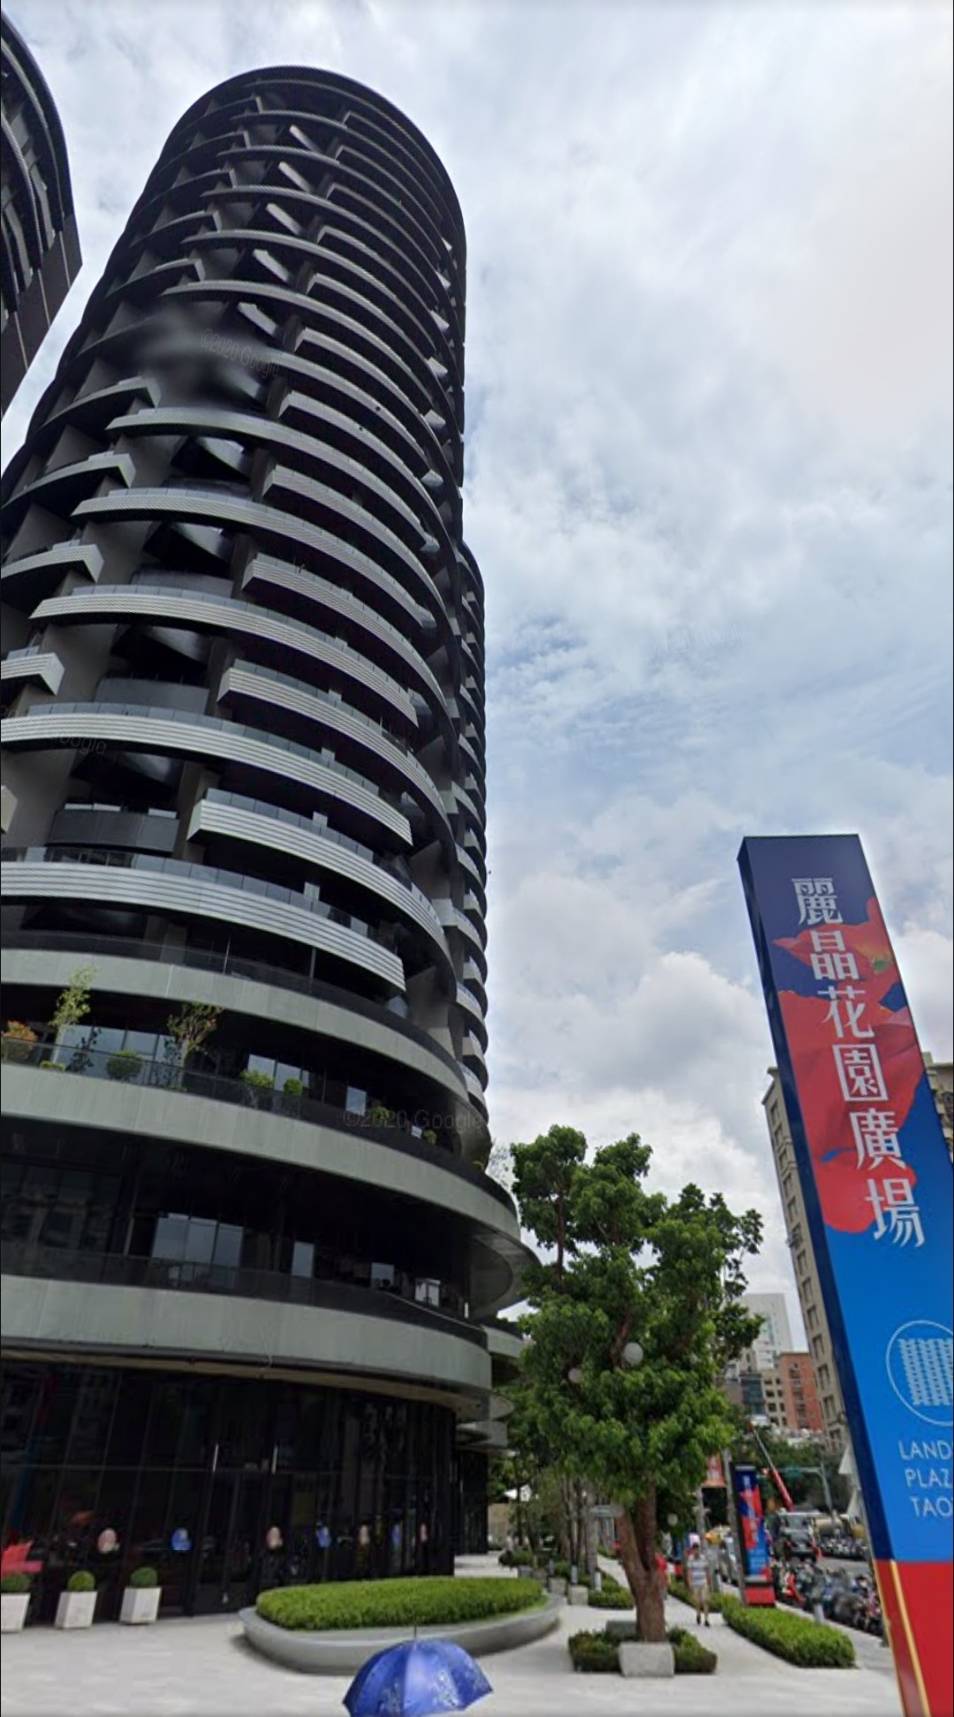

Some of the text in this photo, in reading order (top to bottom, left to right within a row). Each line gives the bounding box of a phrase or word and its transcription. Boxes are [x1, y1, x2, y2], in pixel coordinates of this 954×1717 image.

[791, 877, 925, 1248] 麗晶花園廣場
[898, 1439, 953, 1461] LAND
[910, 1496, 953, 1518] TAO
